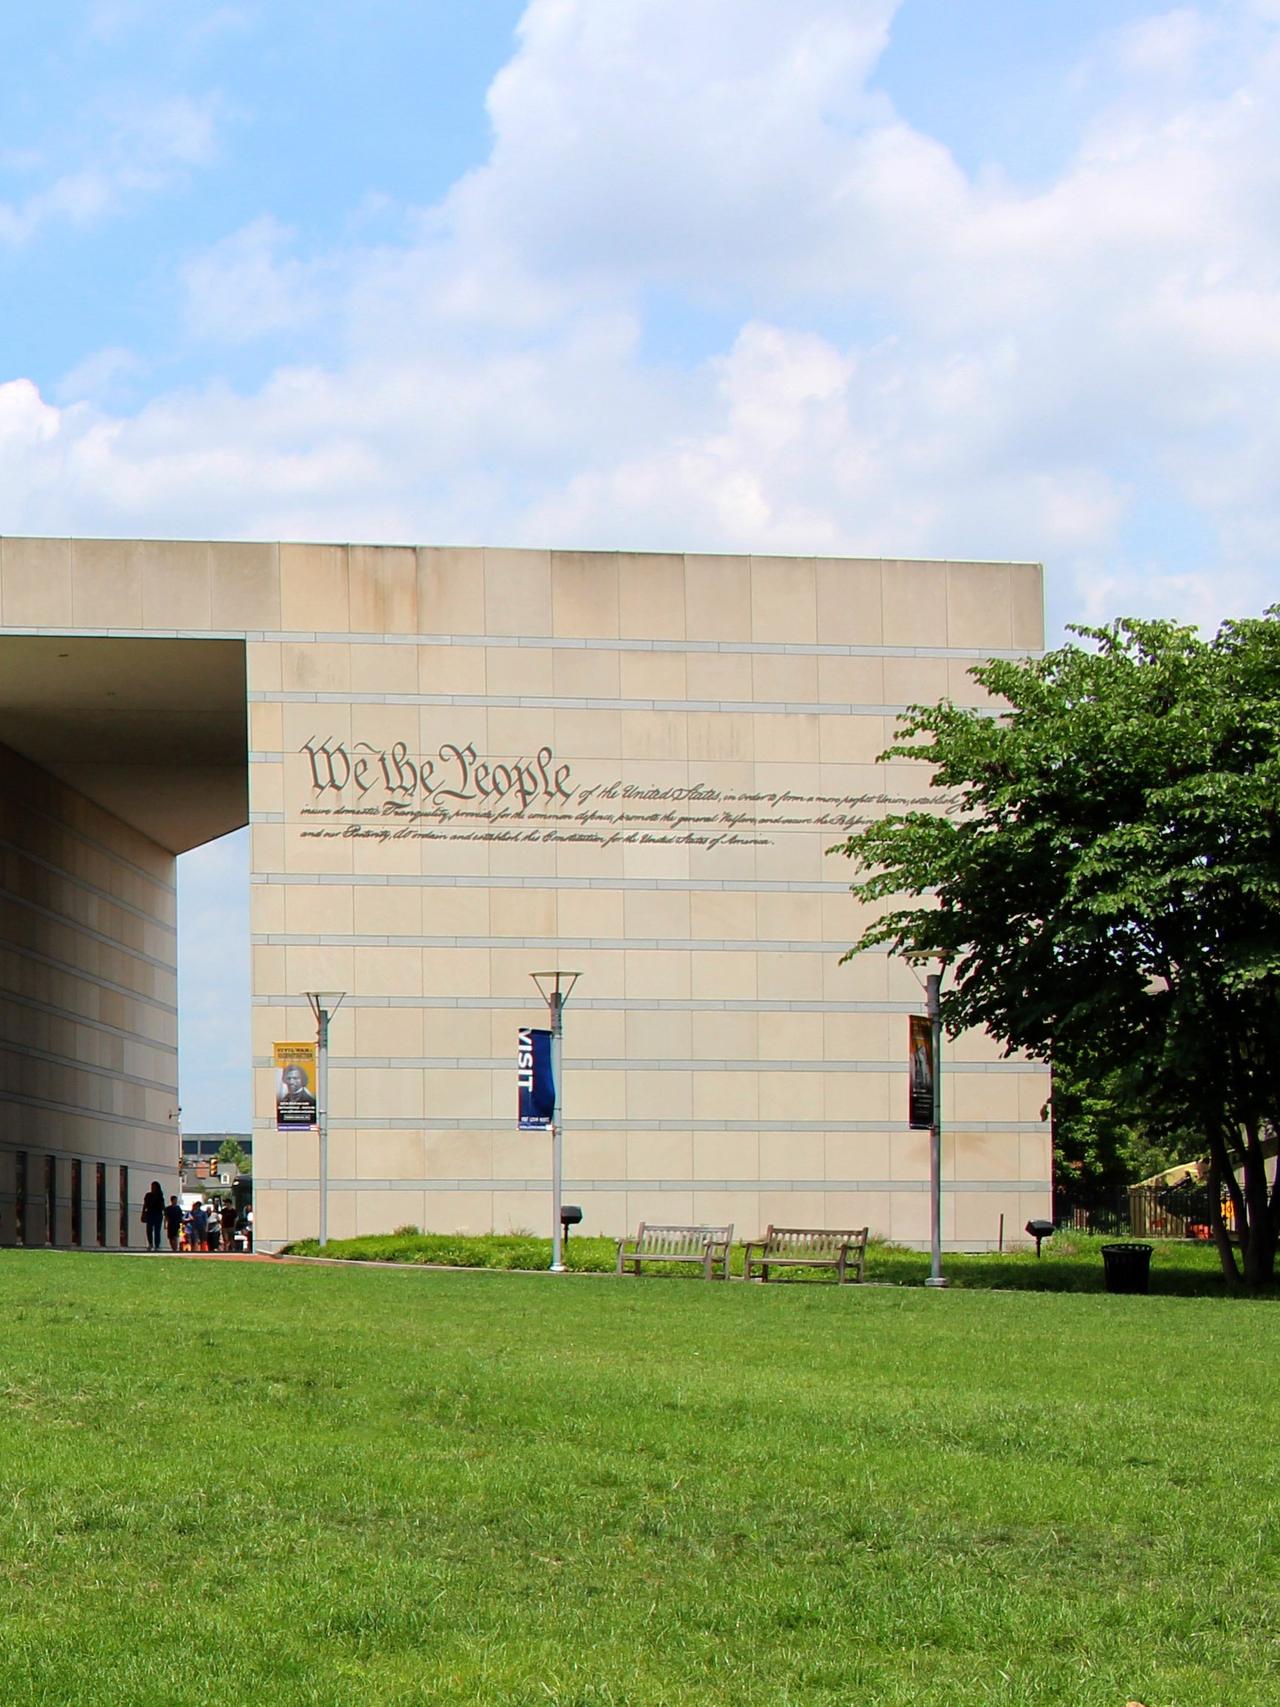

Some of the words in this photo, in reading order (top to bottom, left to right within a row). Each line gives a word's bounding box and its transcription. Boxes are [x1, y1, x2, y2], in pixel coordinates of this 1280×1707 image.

[299, 735, 379, 800] We
[354, 741, 446, 801] the
[433, 741, 581, 815] People
[577, 783, 602, 806] of
[596, 780, 623, 800] the
[621, 783, 673, 801] United
[517, 1027, 534, 1093] VISIT
